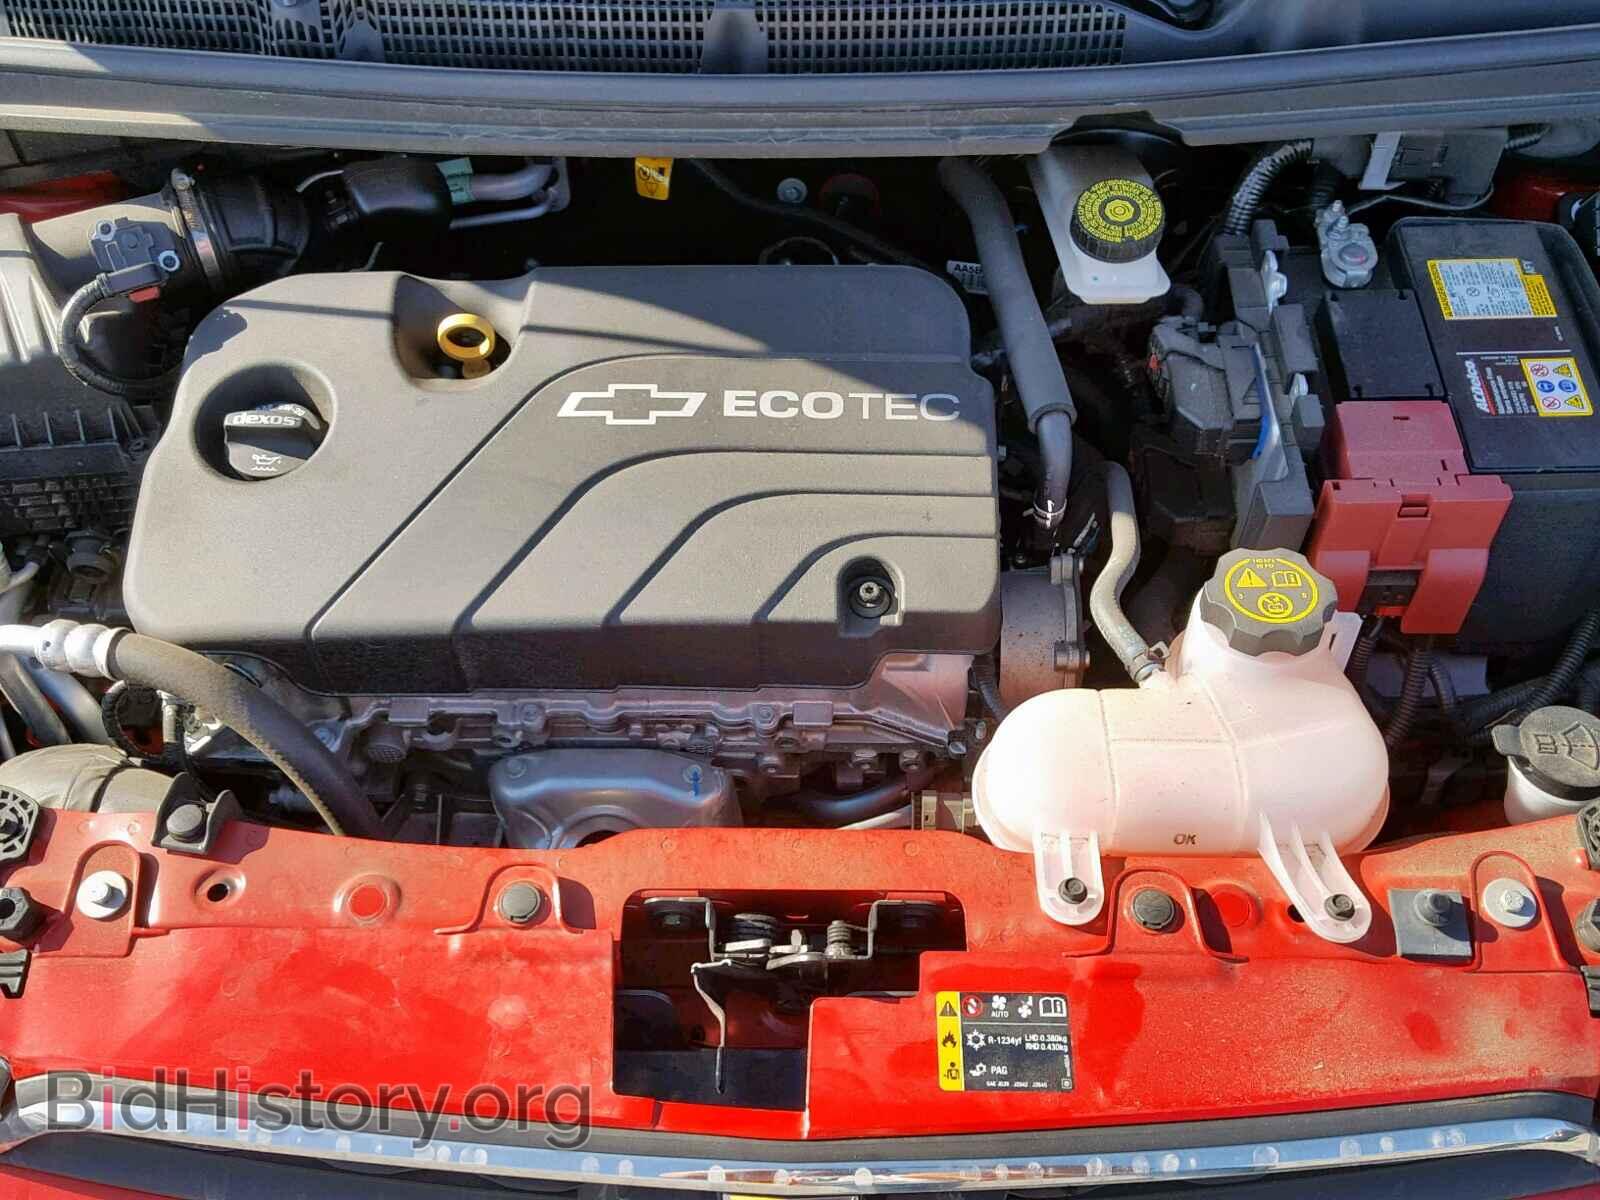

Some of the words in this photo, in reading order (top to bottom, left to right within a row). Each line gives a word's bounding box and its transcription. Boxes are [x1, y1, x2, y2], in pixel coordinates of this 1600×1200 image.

[723, 390, 960, 421] ECOTEC
[232, 412, 296, 426] dexos
[1174, 833, 1197, 846] OK
[991, 1010, 1009, 1019] AUTO
[987, 1035, 1022, 1047] R-1234yf
